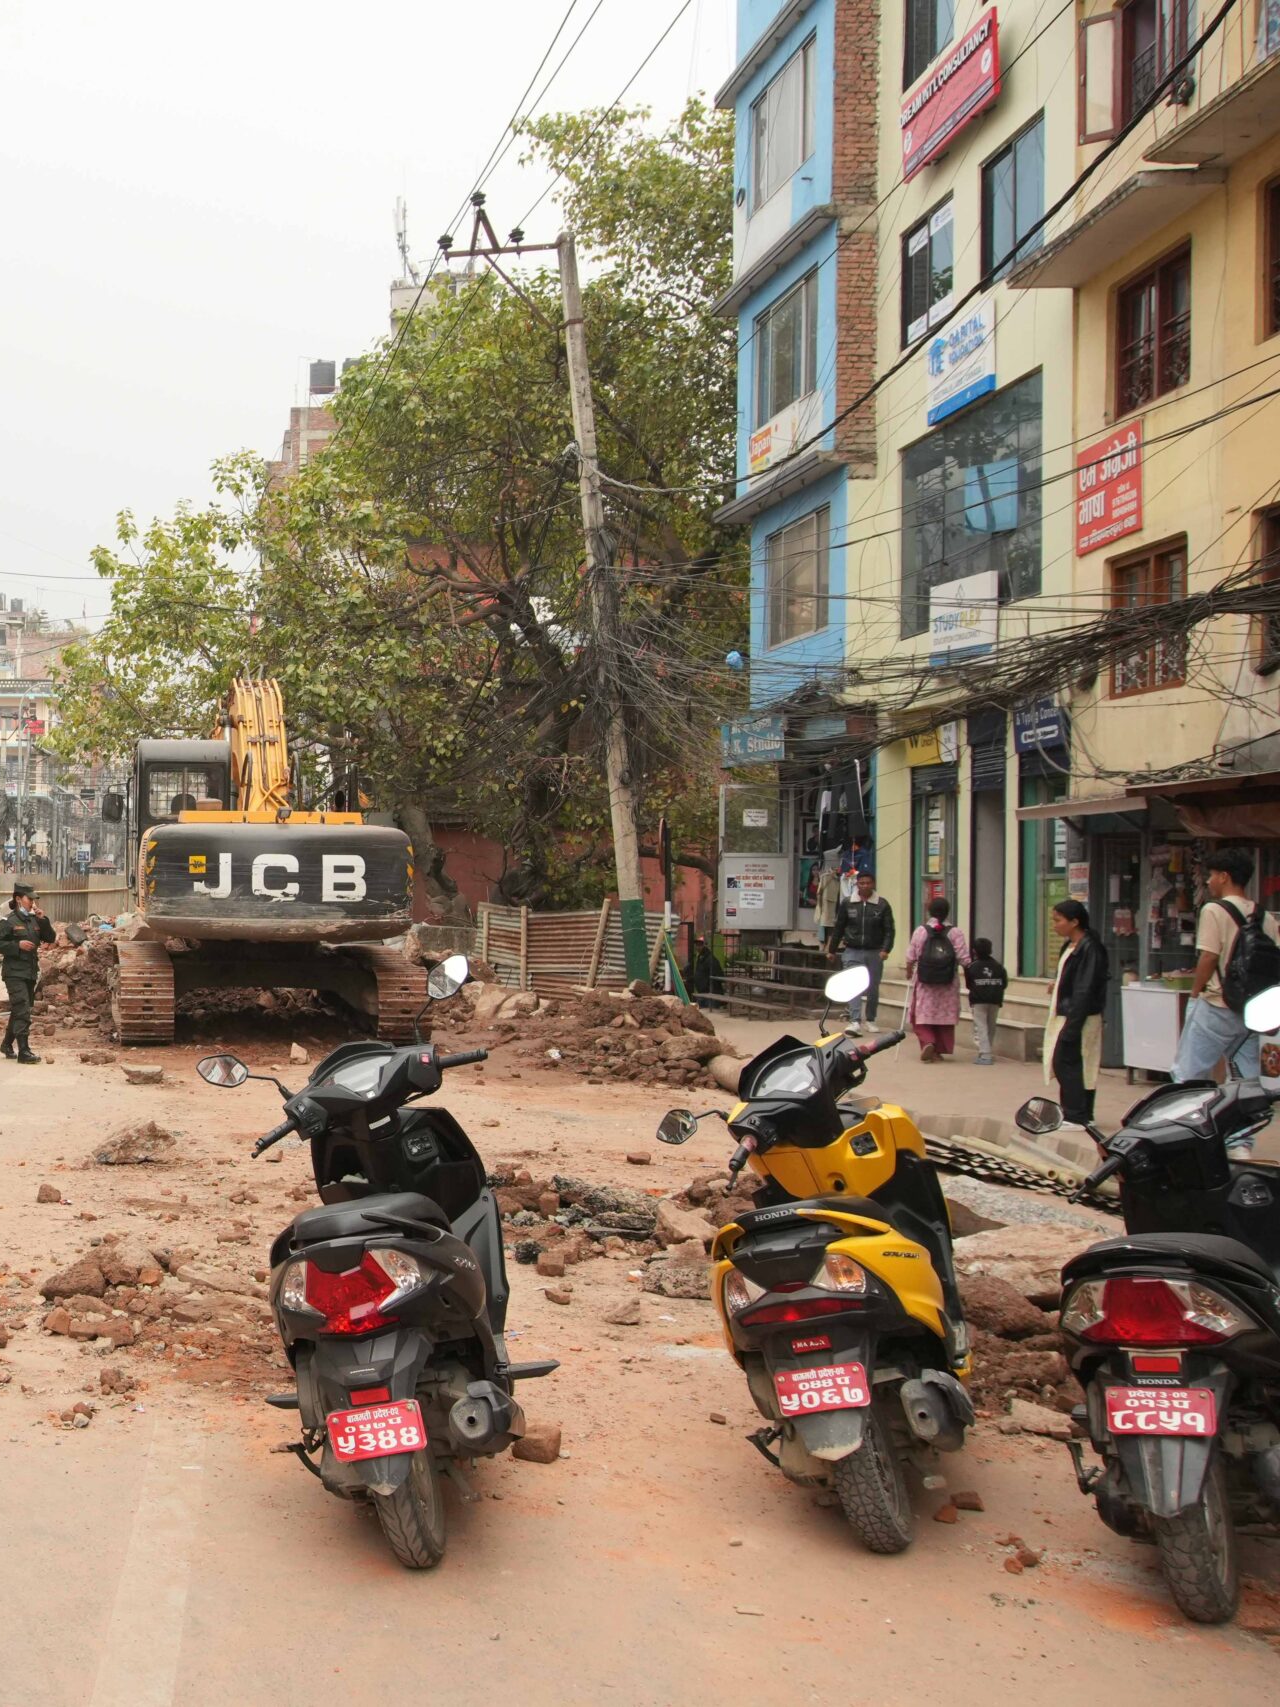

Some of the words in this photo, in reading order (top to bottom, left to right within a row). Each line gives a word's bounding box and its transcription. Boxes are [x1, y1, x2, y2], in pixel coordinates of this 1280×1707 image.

[938, 21, 990, 86] CONSULTANCY
[1079, 490, 1106, 526] भाषा
[748, 733, 781, 753] Studio
[193, 853, 367, 902] JCB
[754, 1207, 797, 1223] HONDA
[780, 1386, 864, 1411] ५०६७
[1111, 1409, 1206, 1433] ८८५१
[337, 1426, 420, 1455] ५३४४
